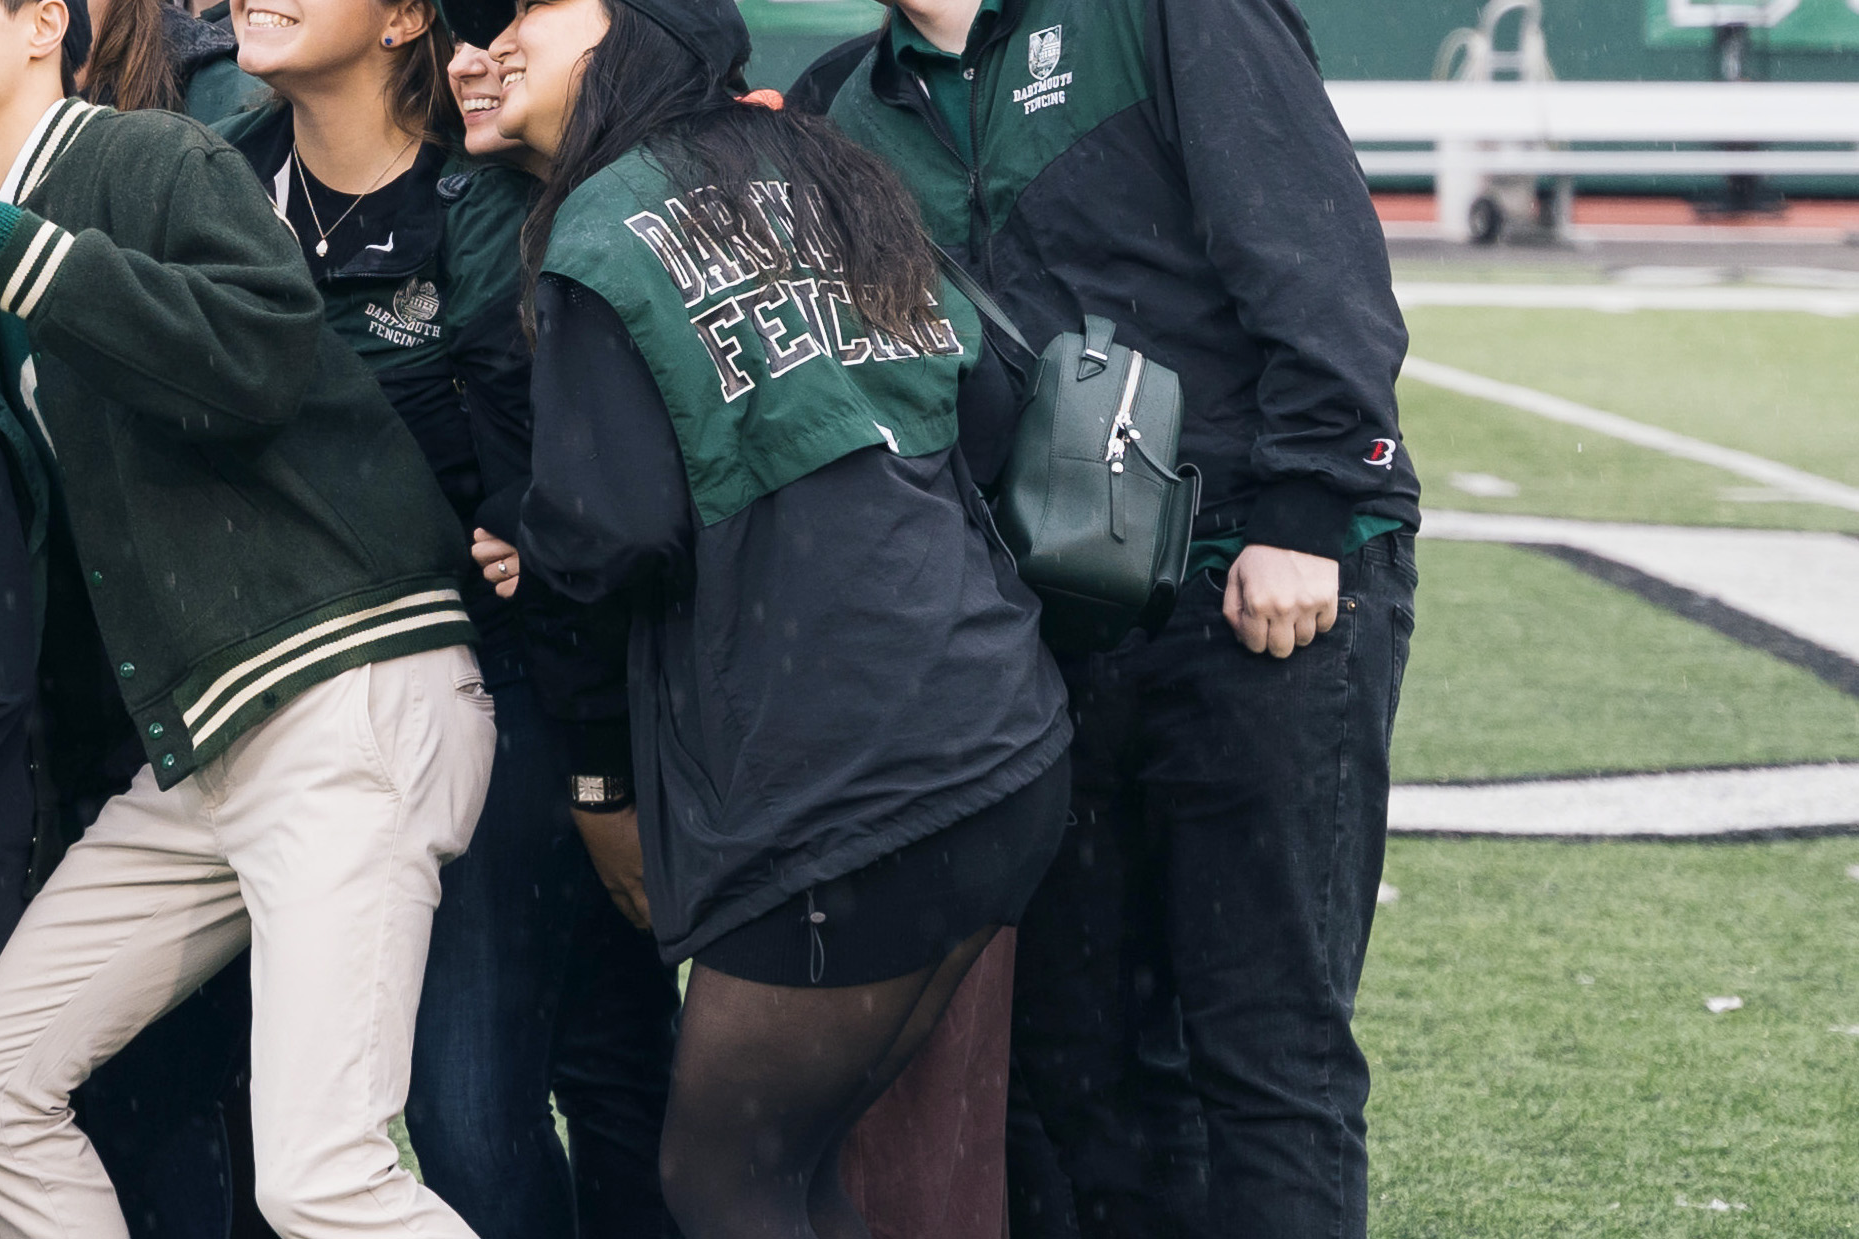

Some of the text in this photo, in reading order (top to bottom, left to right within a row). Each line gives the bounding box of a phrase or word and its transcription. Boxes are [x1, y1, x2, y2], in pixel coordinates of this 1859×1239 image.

[1013, 71, 1073, 102] DARTMOUTH
[1023, 90, 1066, 115] FENCING
[364, 302, 441, 338] DARTOUTH
